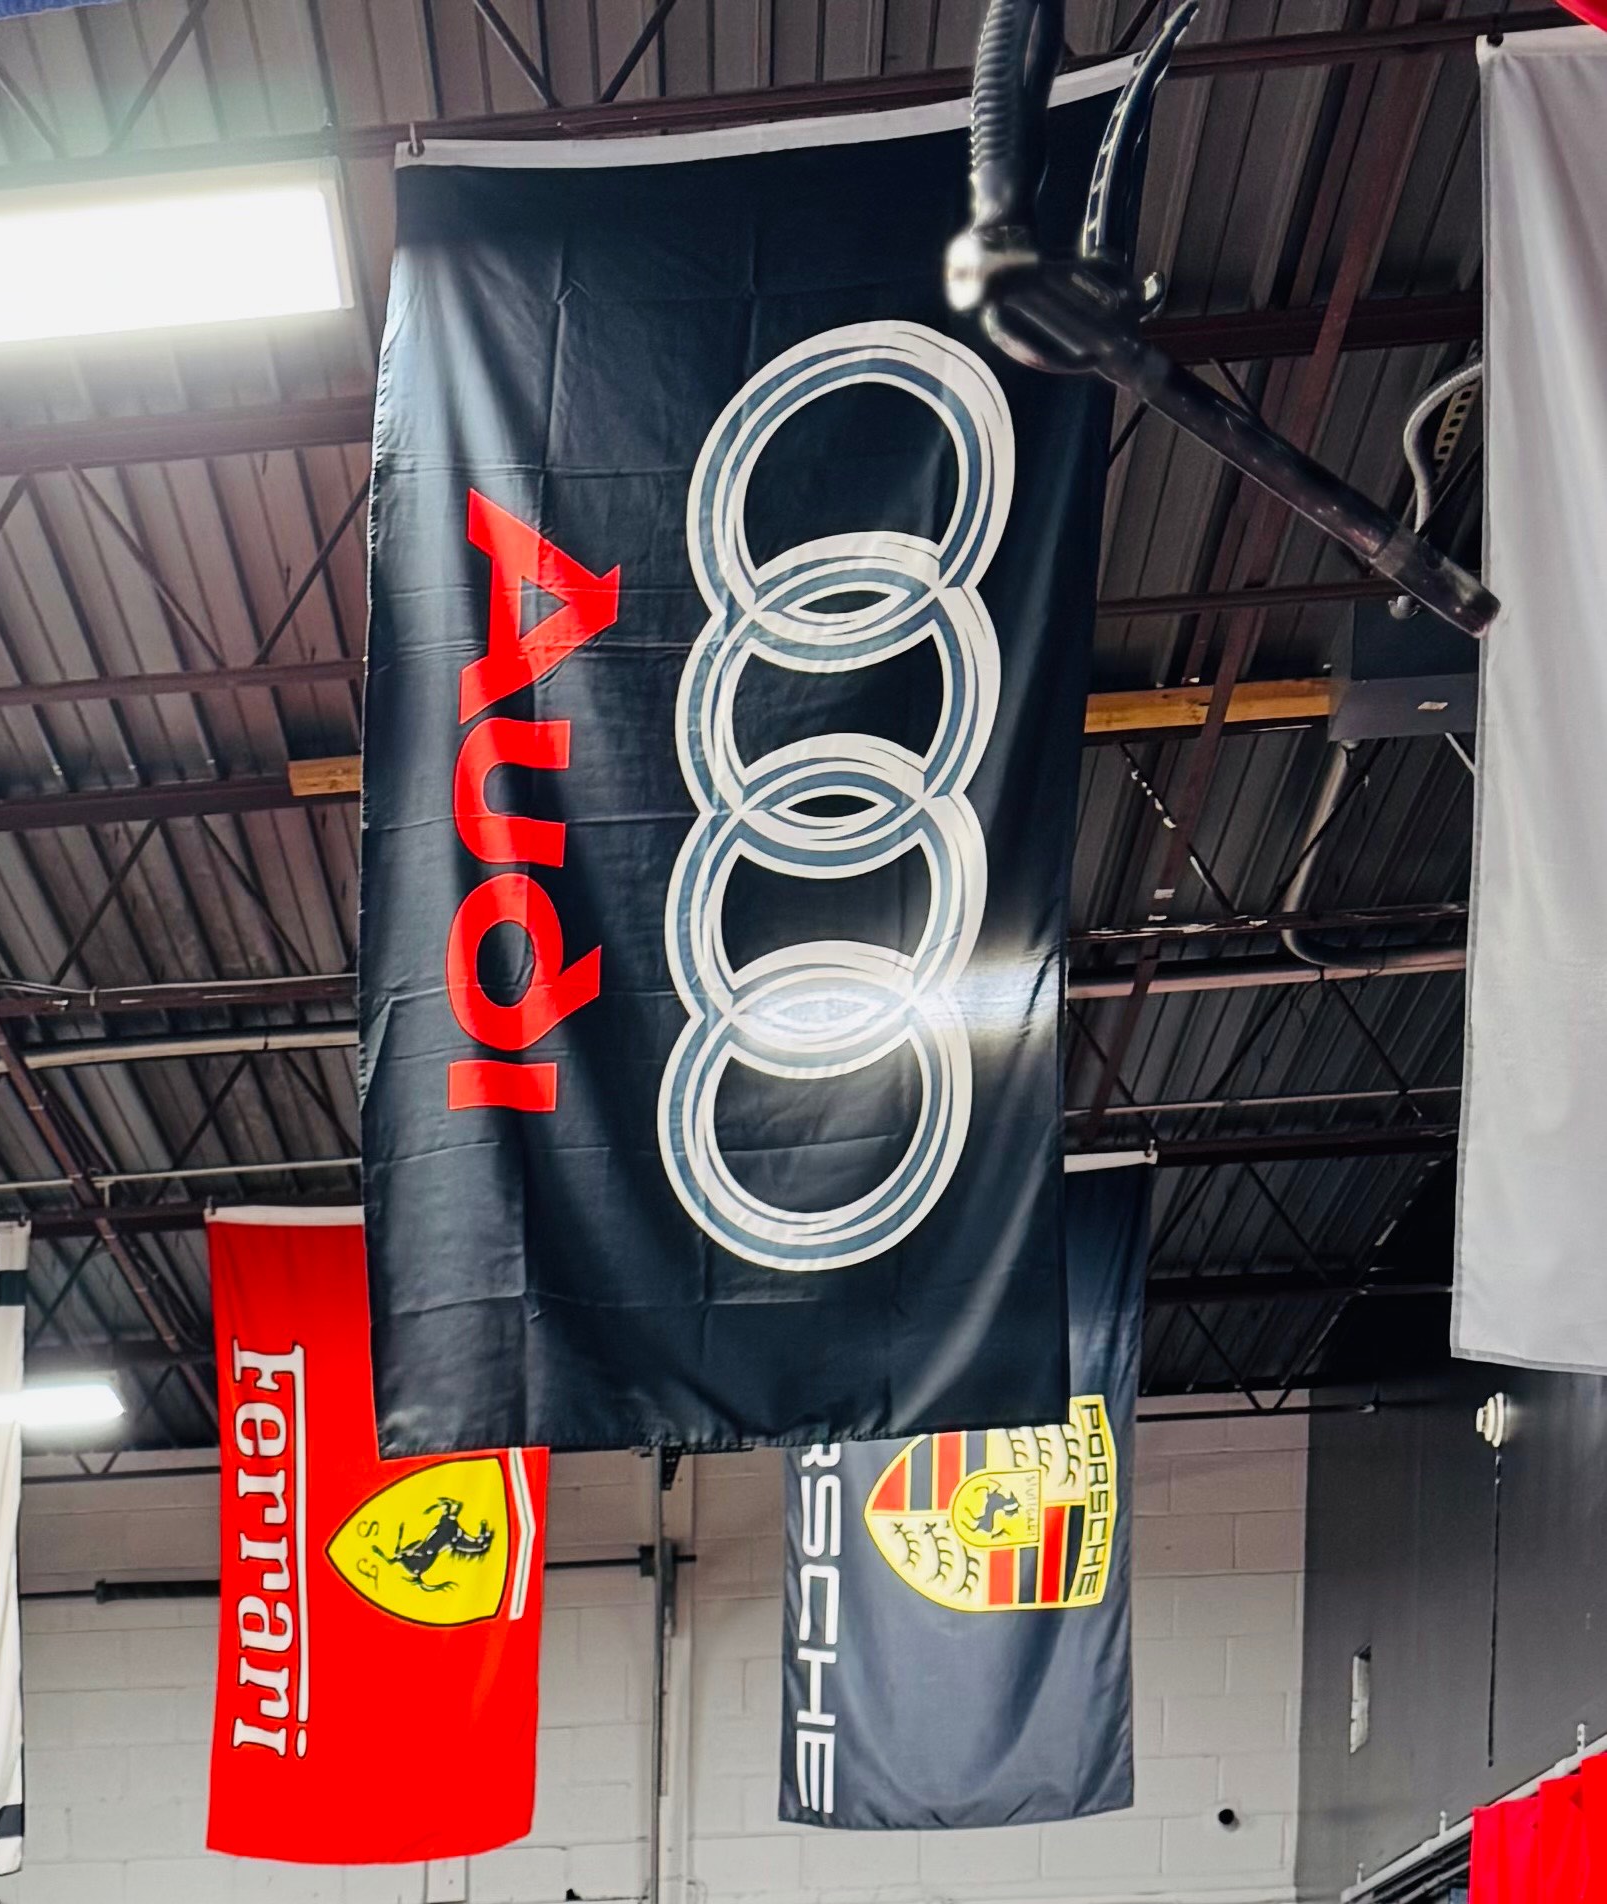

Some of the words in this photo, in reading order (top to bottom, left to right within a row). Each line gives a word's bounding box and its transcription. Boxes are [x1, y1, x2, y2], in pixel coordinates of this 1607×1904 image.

[445, 486, 621, 1113] Audi
[231, 1338, 308, 1760] Ferrari
[1075, 1403, 1109, 1598] PORSCHE
